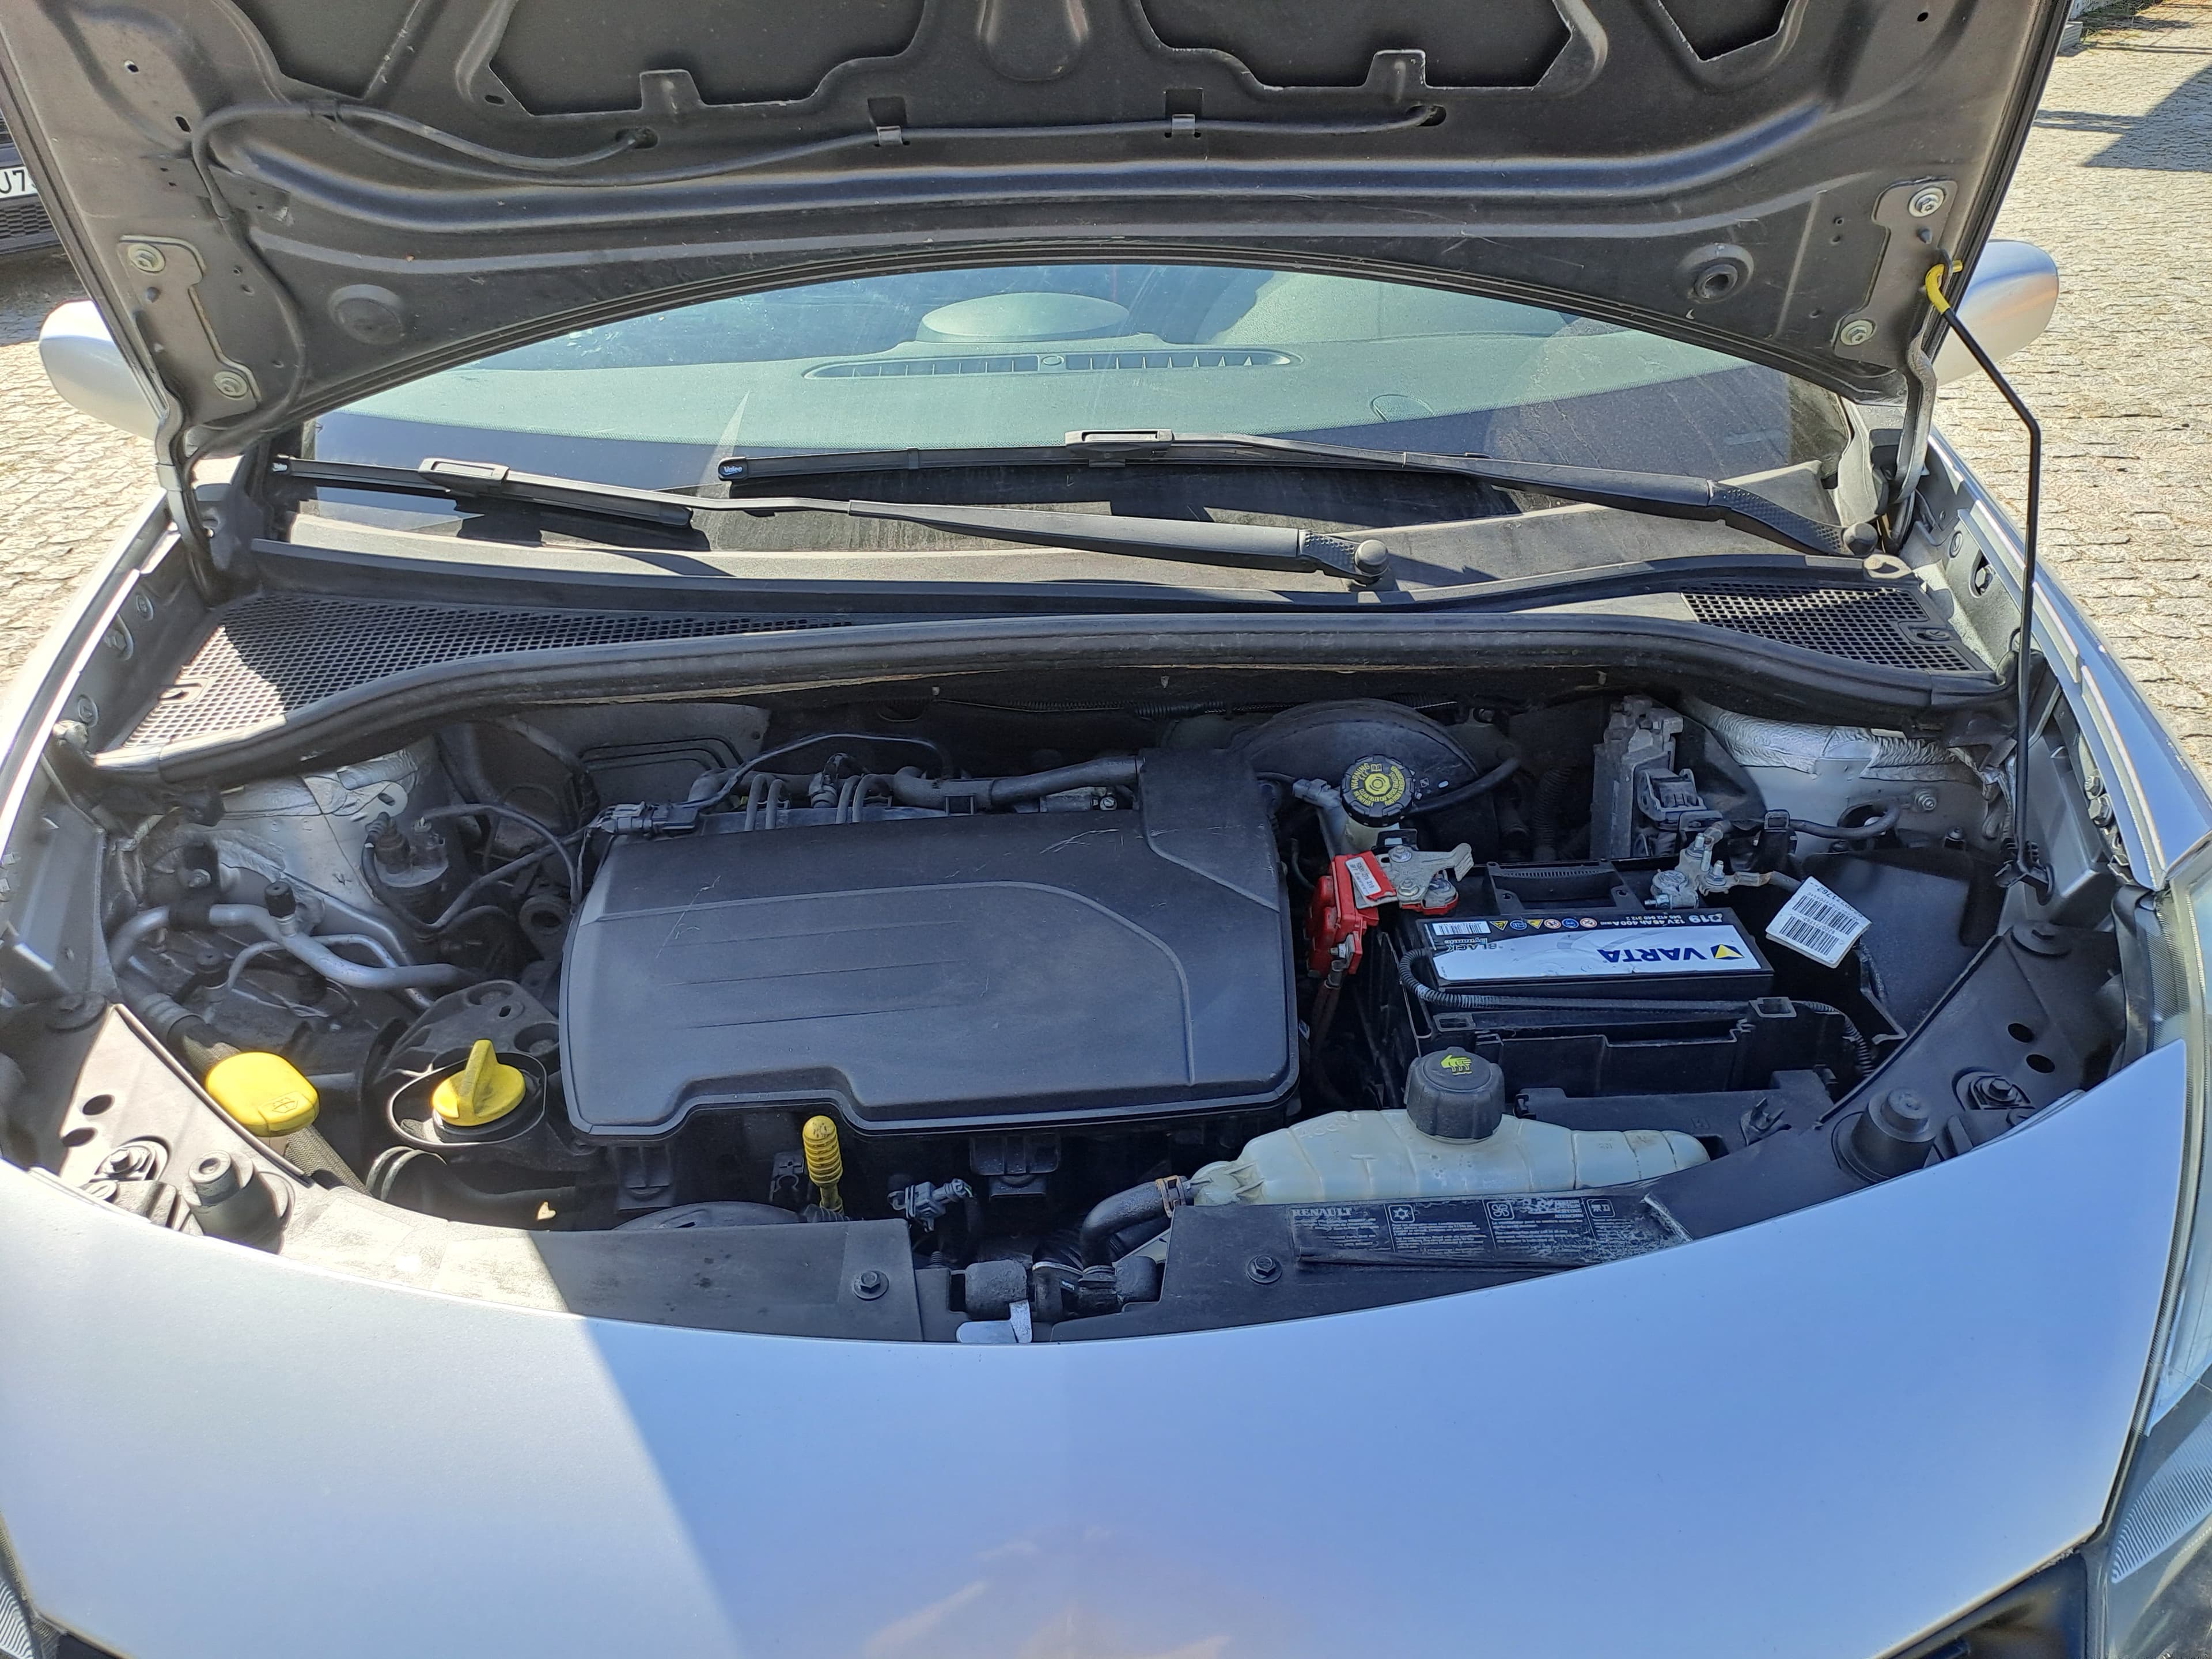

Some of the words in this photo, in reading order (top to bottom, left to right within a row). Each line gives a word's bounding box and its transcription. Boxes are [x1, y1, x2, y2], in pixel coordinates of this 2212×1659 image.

[1351, 763, 1370, 790] WARNING
[1445, 943, 1497, 952] BLACK
[1596, 947, 1708, 963] VARTA
[1292, 1207, 1353, 1217] RENAULT
